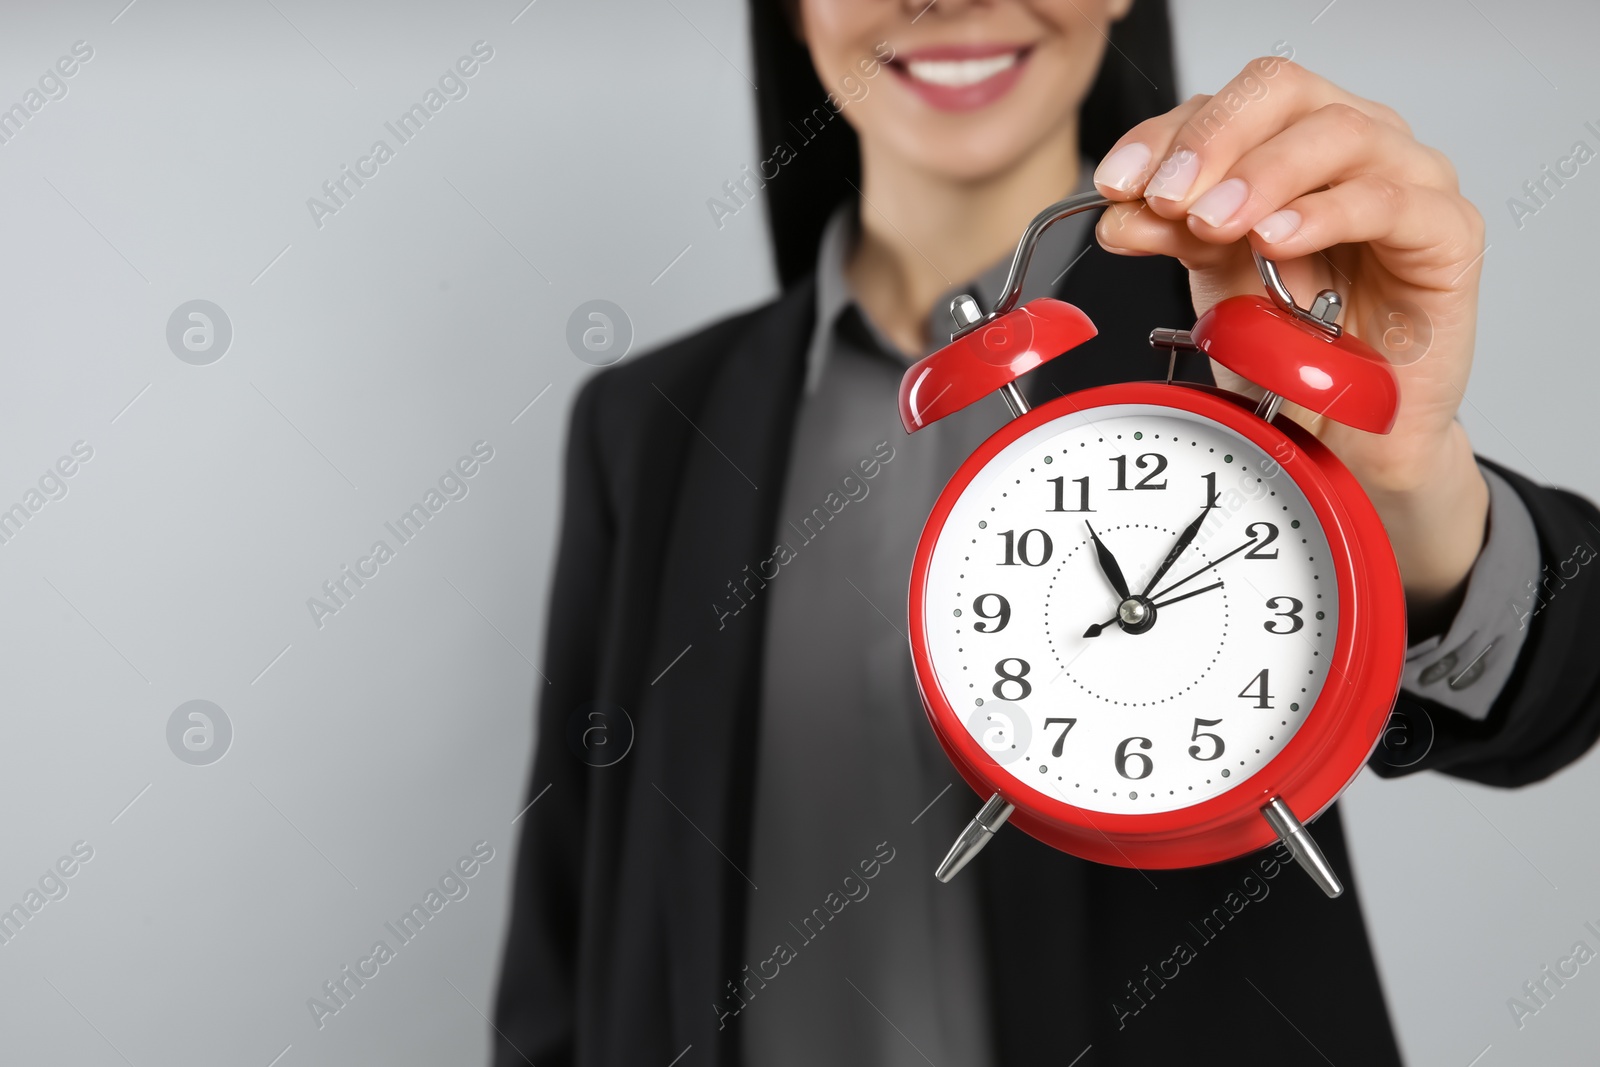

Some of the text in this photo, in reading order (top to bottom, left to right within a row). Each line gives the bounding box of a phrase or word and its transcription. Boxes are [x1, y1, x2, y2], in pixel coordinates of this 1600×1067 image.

[1108, 453, 1167, 490] 12
[1200, 472, 1221, 508] 1
[1046, 476, 1097, 512] 11
[996, 529, 1053, 567] 10
[1244, 522, 1279, 559] 2
[972, 593, 1011, 633] 9
[1264, 597, 1303, 634] 3
[992, 658, 1032, 701] 8
[1237, 669, 1274, 709] 4
[1043, 718, 1077, 757] 7
[1188, 718, 1225, 761] 5
[1114, 737, 1153, 780] 6
